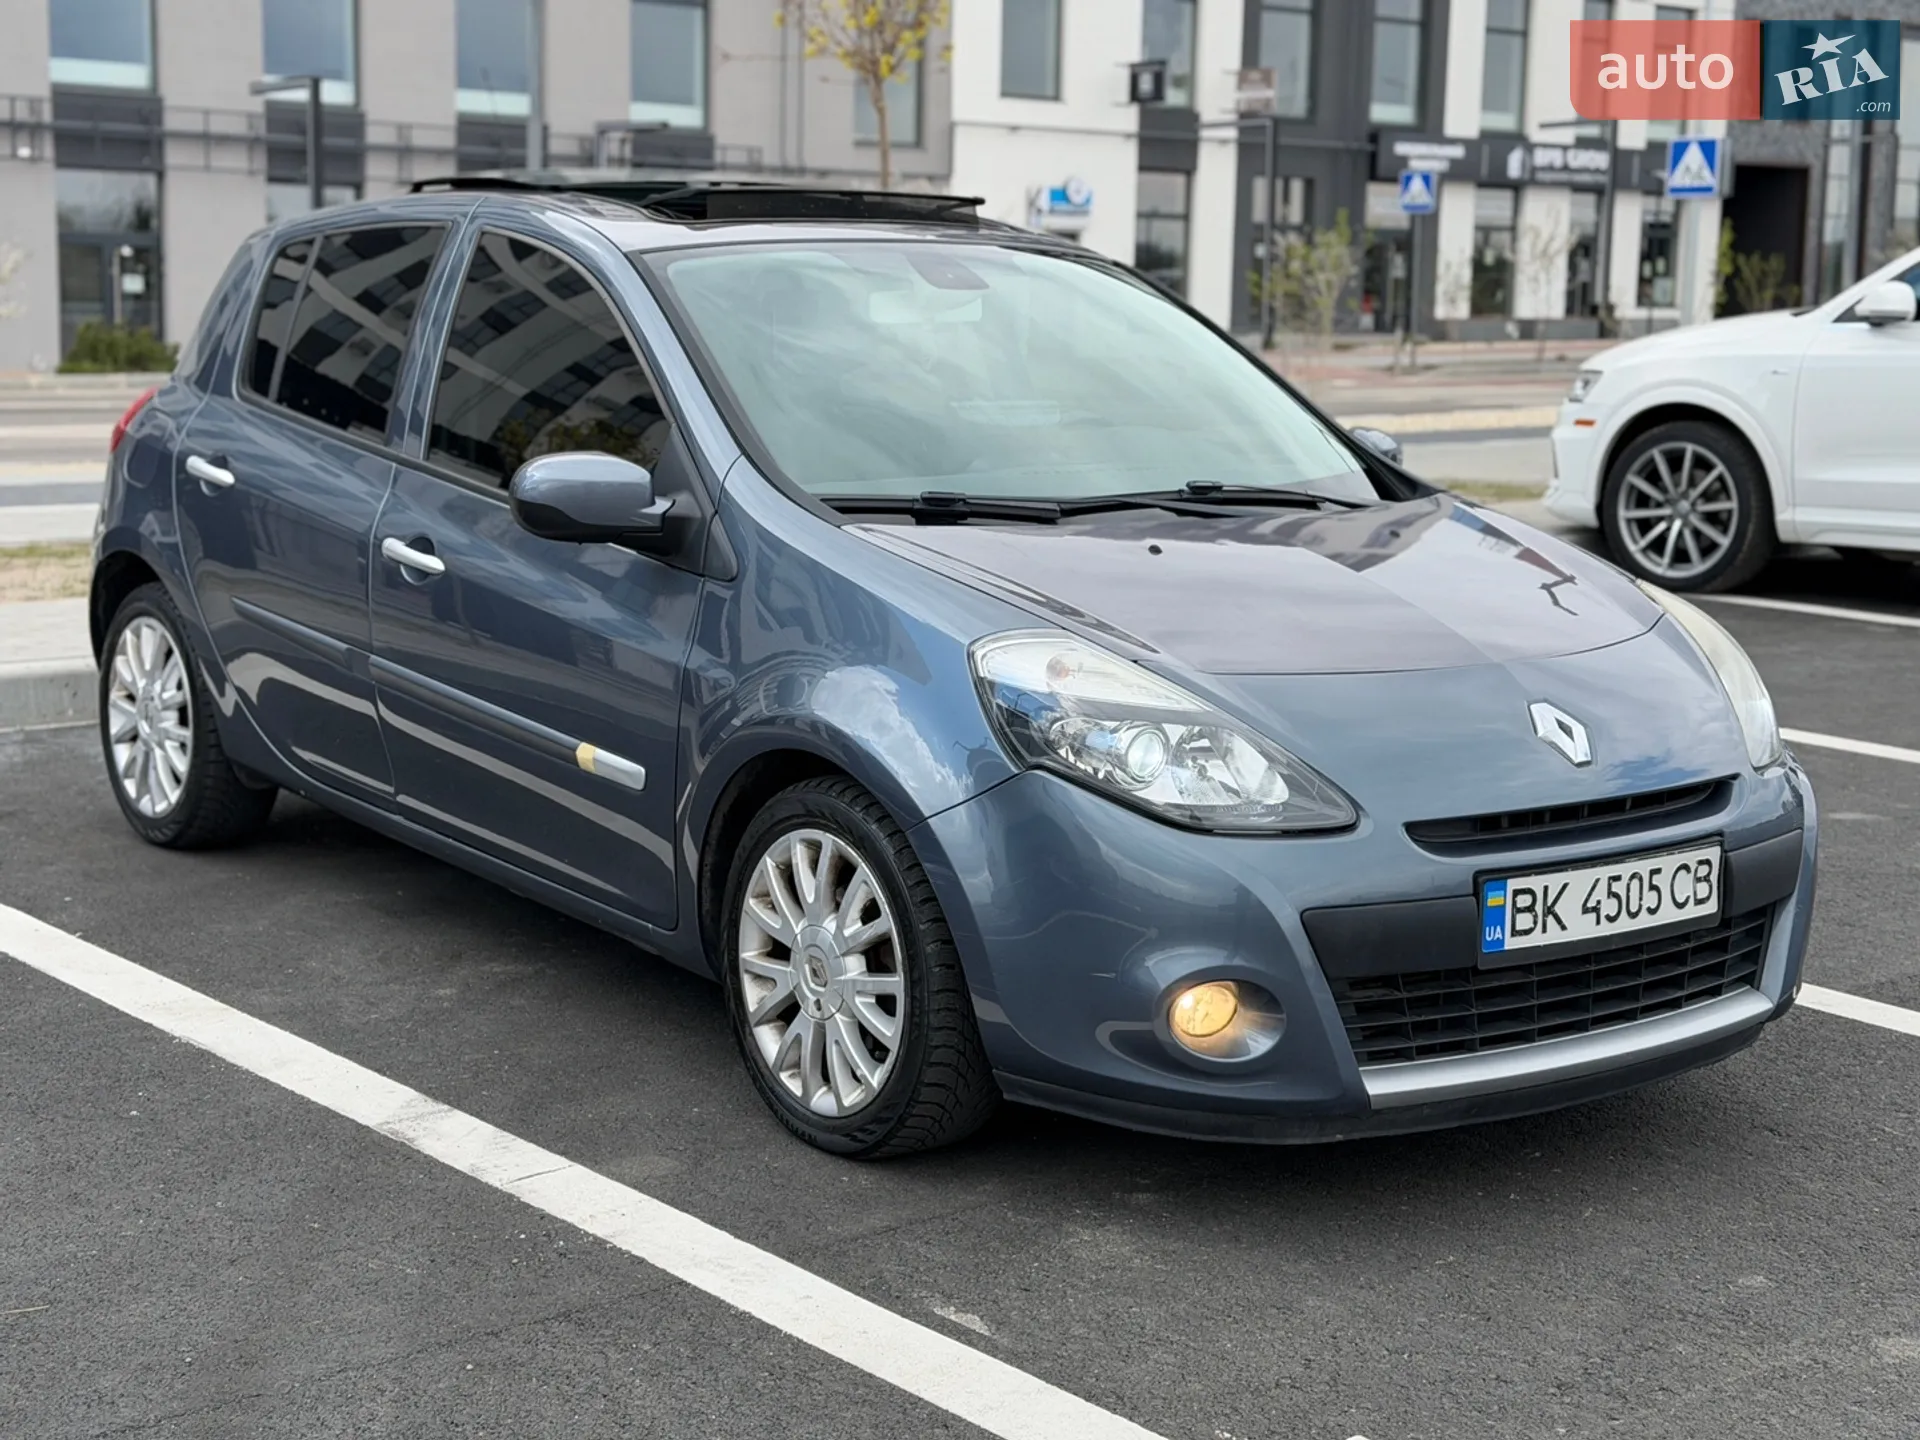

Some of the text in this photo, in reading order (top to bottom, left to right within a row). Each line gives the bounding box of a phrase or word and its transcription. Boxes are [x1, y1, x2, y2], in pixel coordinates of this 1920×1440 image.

[1510, 858, 1713, 938] BK 4505 CB
[1485, 925, 1503, 941] UA
